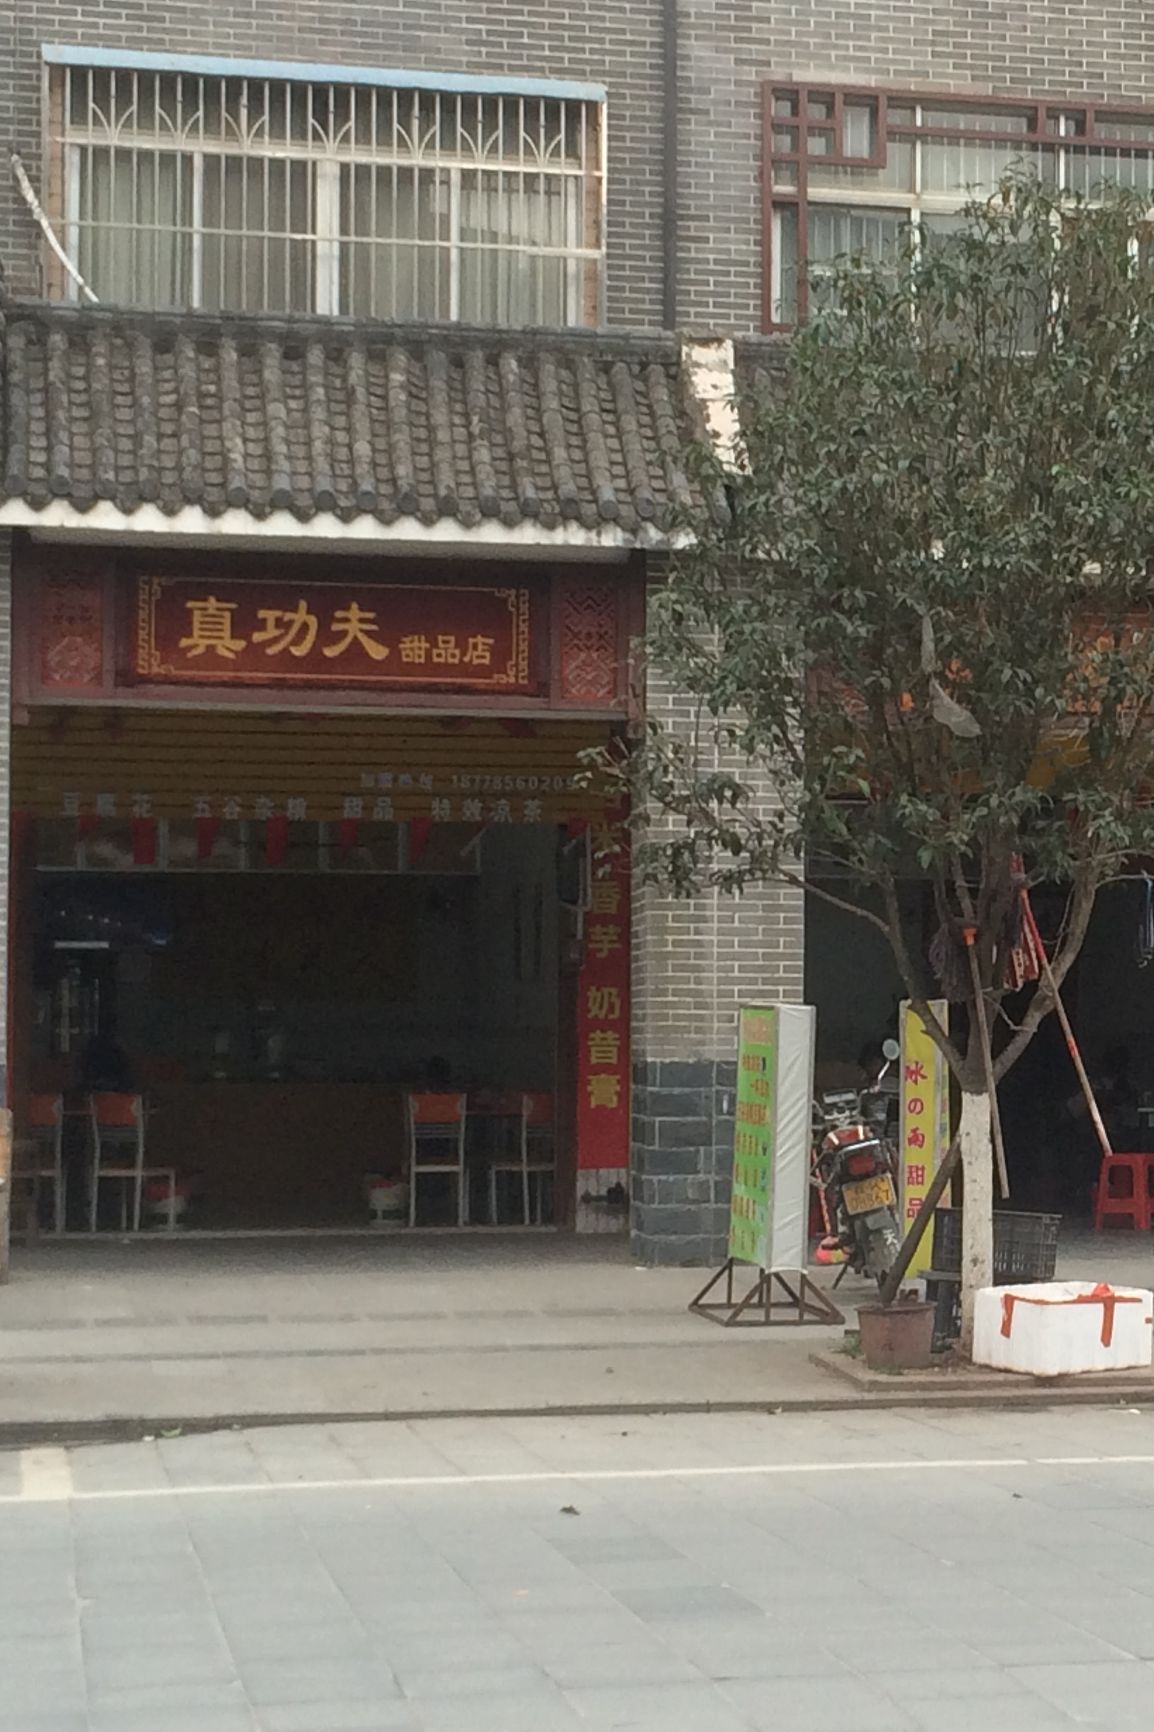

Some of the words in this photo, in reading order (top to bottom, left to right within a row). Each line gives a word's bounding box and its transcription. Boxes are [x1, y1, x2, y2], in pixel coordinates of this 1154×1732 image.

[179, 595, 389, 661] 真功夫
[399, 634, 494, 665] 甜品店
